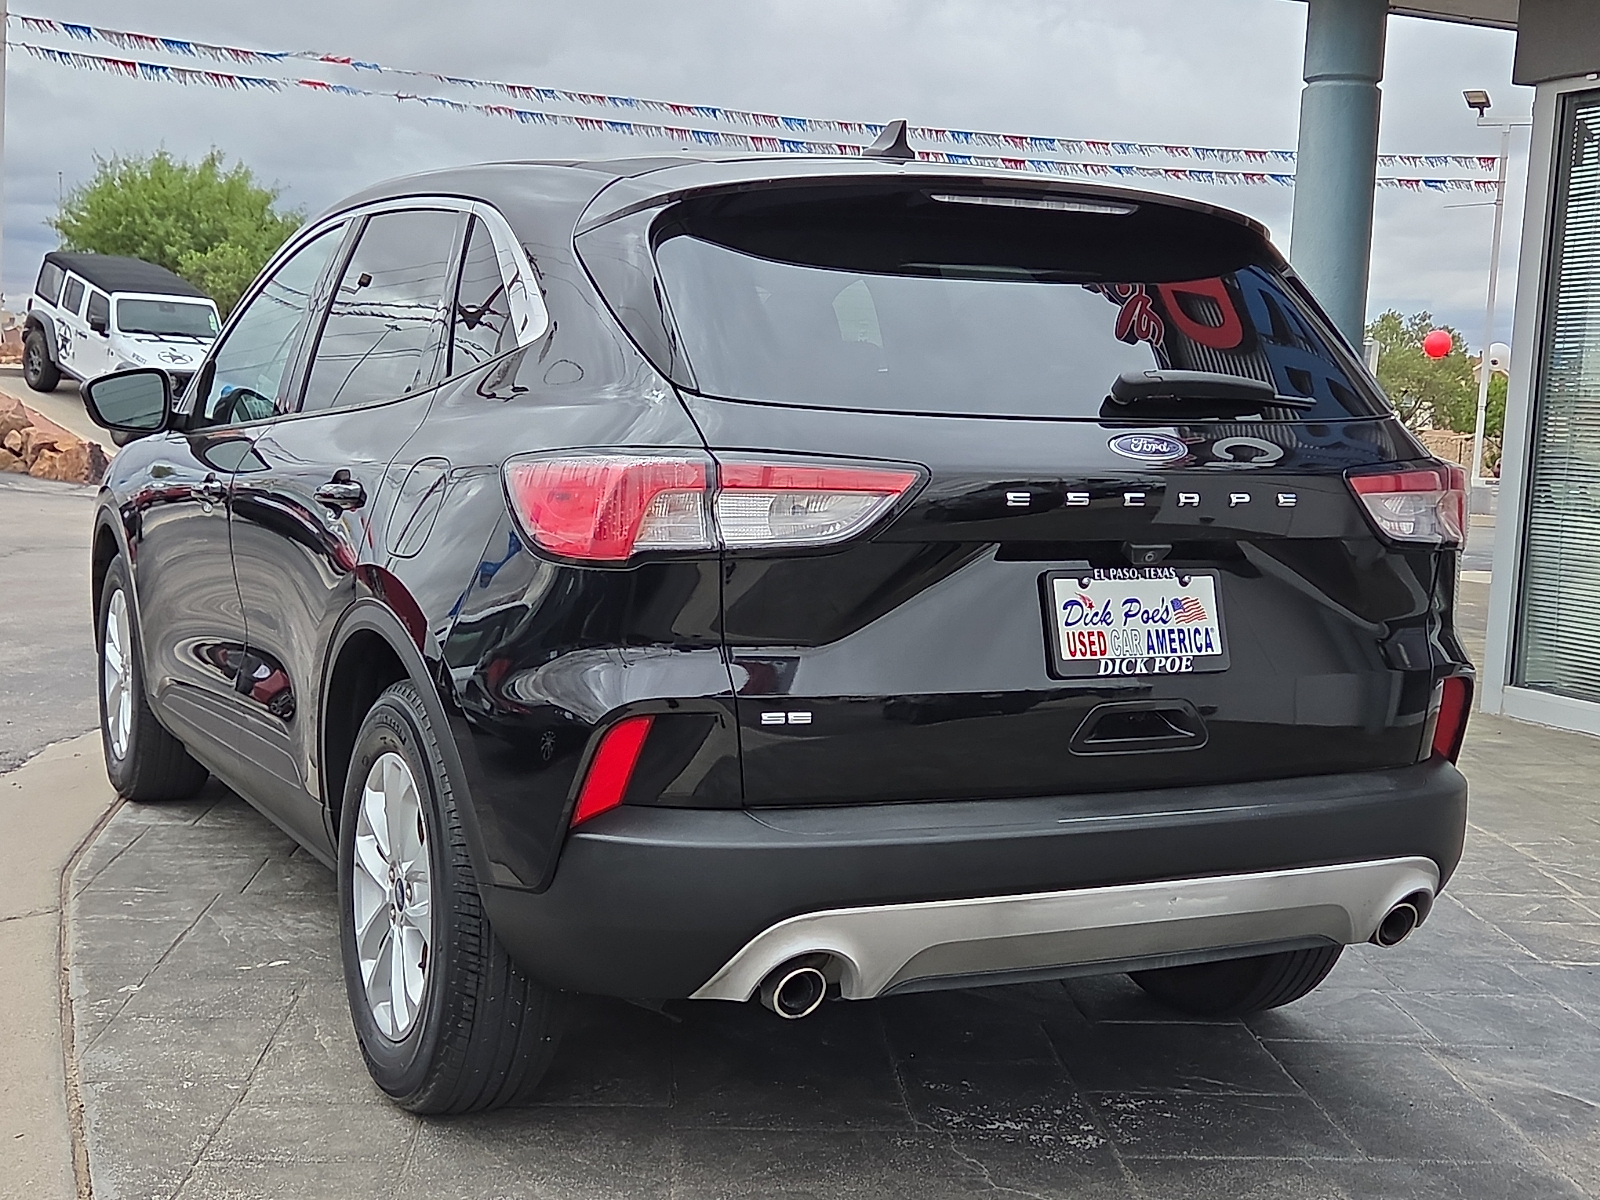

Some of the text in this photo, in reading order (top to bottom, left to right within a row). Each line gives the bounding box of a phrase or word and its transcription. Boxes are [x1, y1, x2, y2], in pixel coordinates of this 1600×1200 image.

[1130, 437, 1170, 452] Ford
[1005, 491, 1298, 507] ESCAPE
[1093, 567, 1177, 580] EL PASO, TEXAS
[1062, 597, 1172, 627] Dick Poe's
[1066, 627, 1214, 658] USED CAR AMERICA
[1098, 656, 1194, 676] DICK POE
[761, 712, 812, 725] SE
